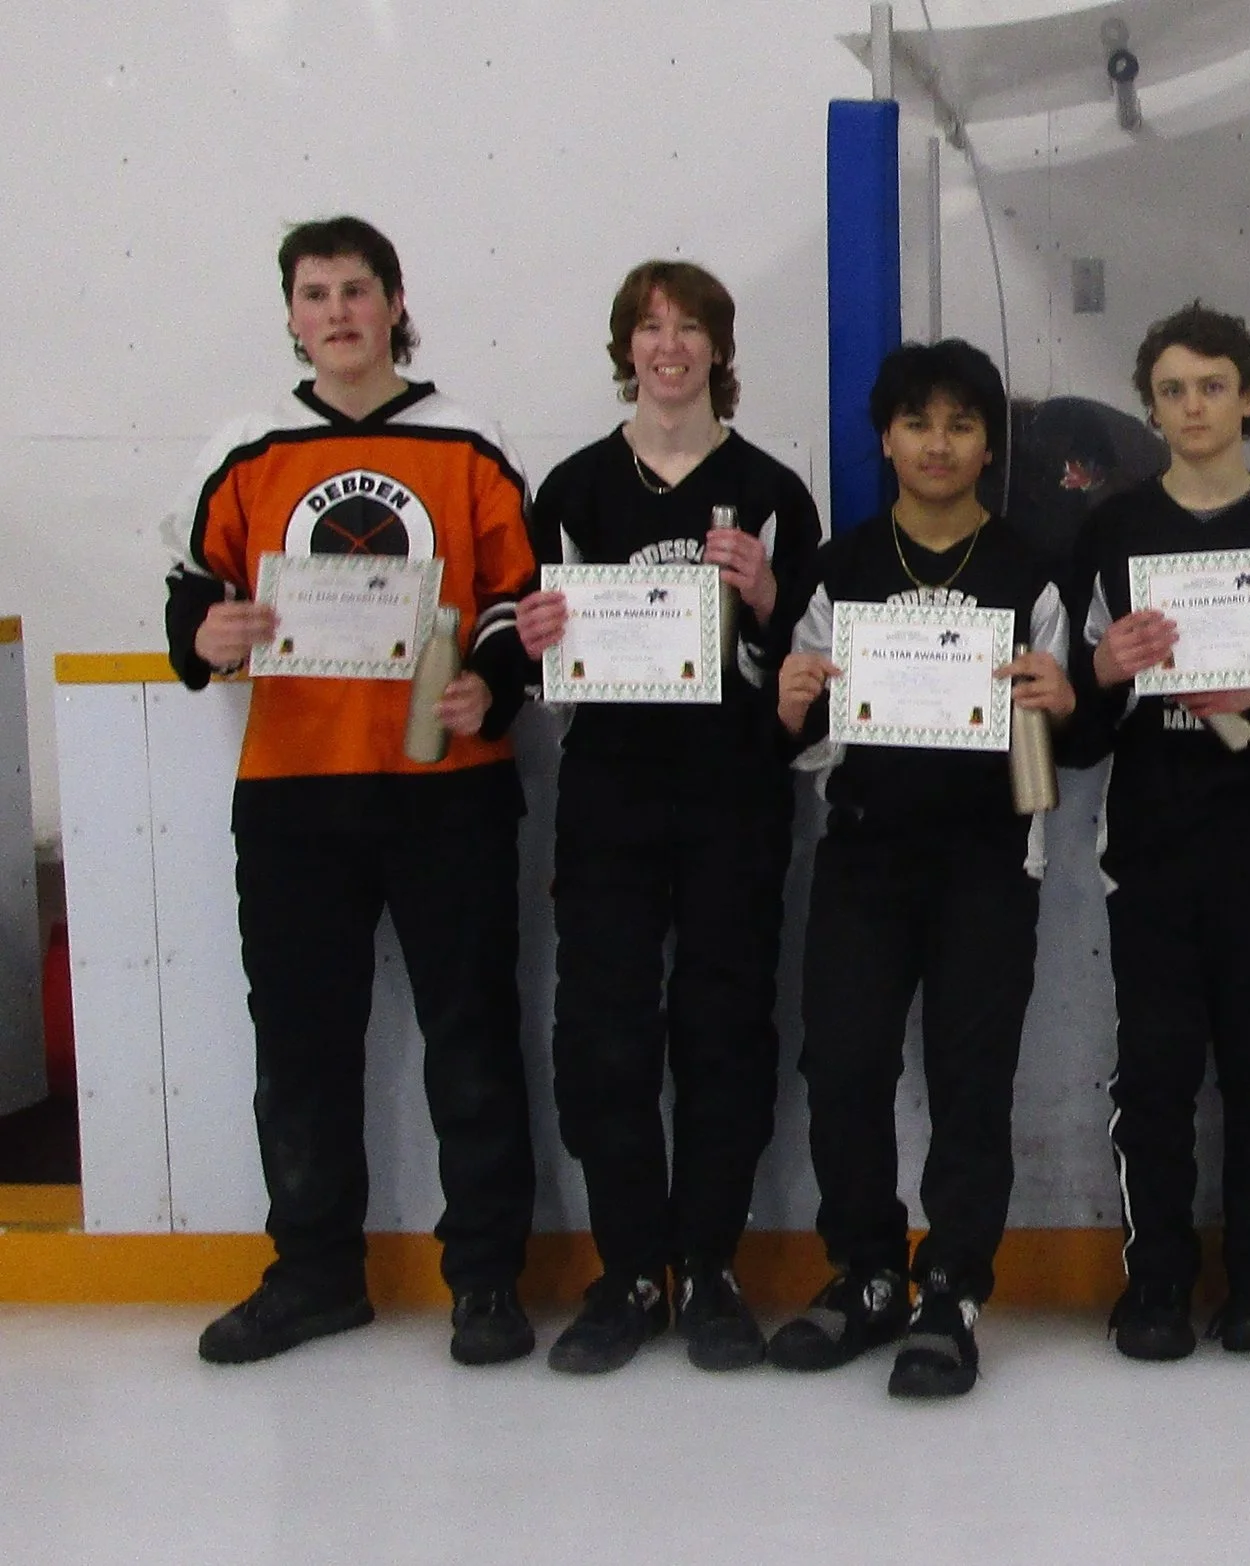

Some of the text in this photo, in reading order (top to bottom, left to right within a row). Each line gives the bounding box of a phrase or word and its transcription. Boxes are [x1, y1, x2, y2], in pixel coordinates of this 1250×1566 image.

[307, 475, 411, 513] DEBDEN
[1171, 599, 1185, 609] ALL
[1188, 597, 1210, 608] STAR
[1212, 595, 1245, 606] AWARD
[582, 608, 596, 619] ALL
[599, 608, 621, 619] STAR
[624, 608, 658, 619] AWARD
[872, 649, 886, 660] ALL
[889, 649, 912, 661] STAR
[914, 650, 948, 662] AWARD
